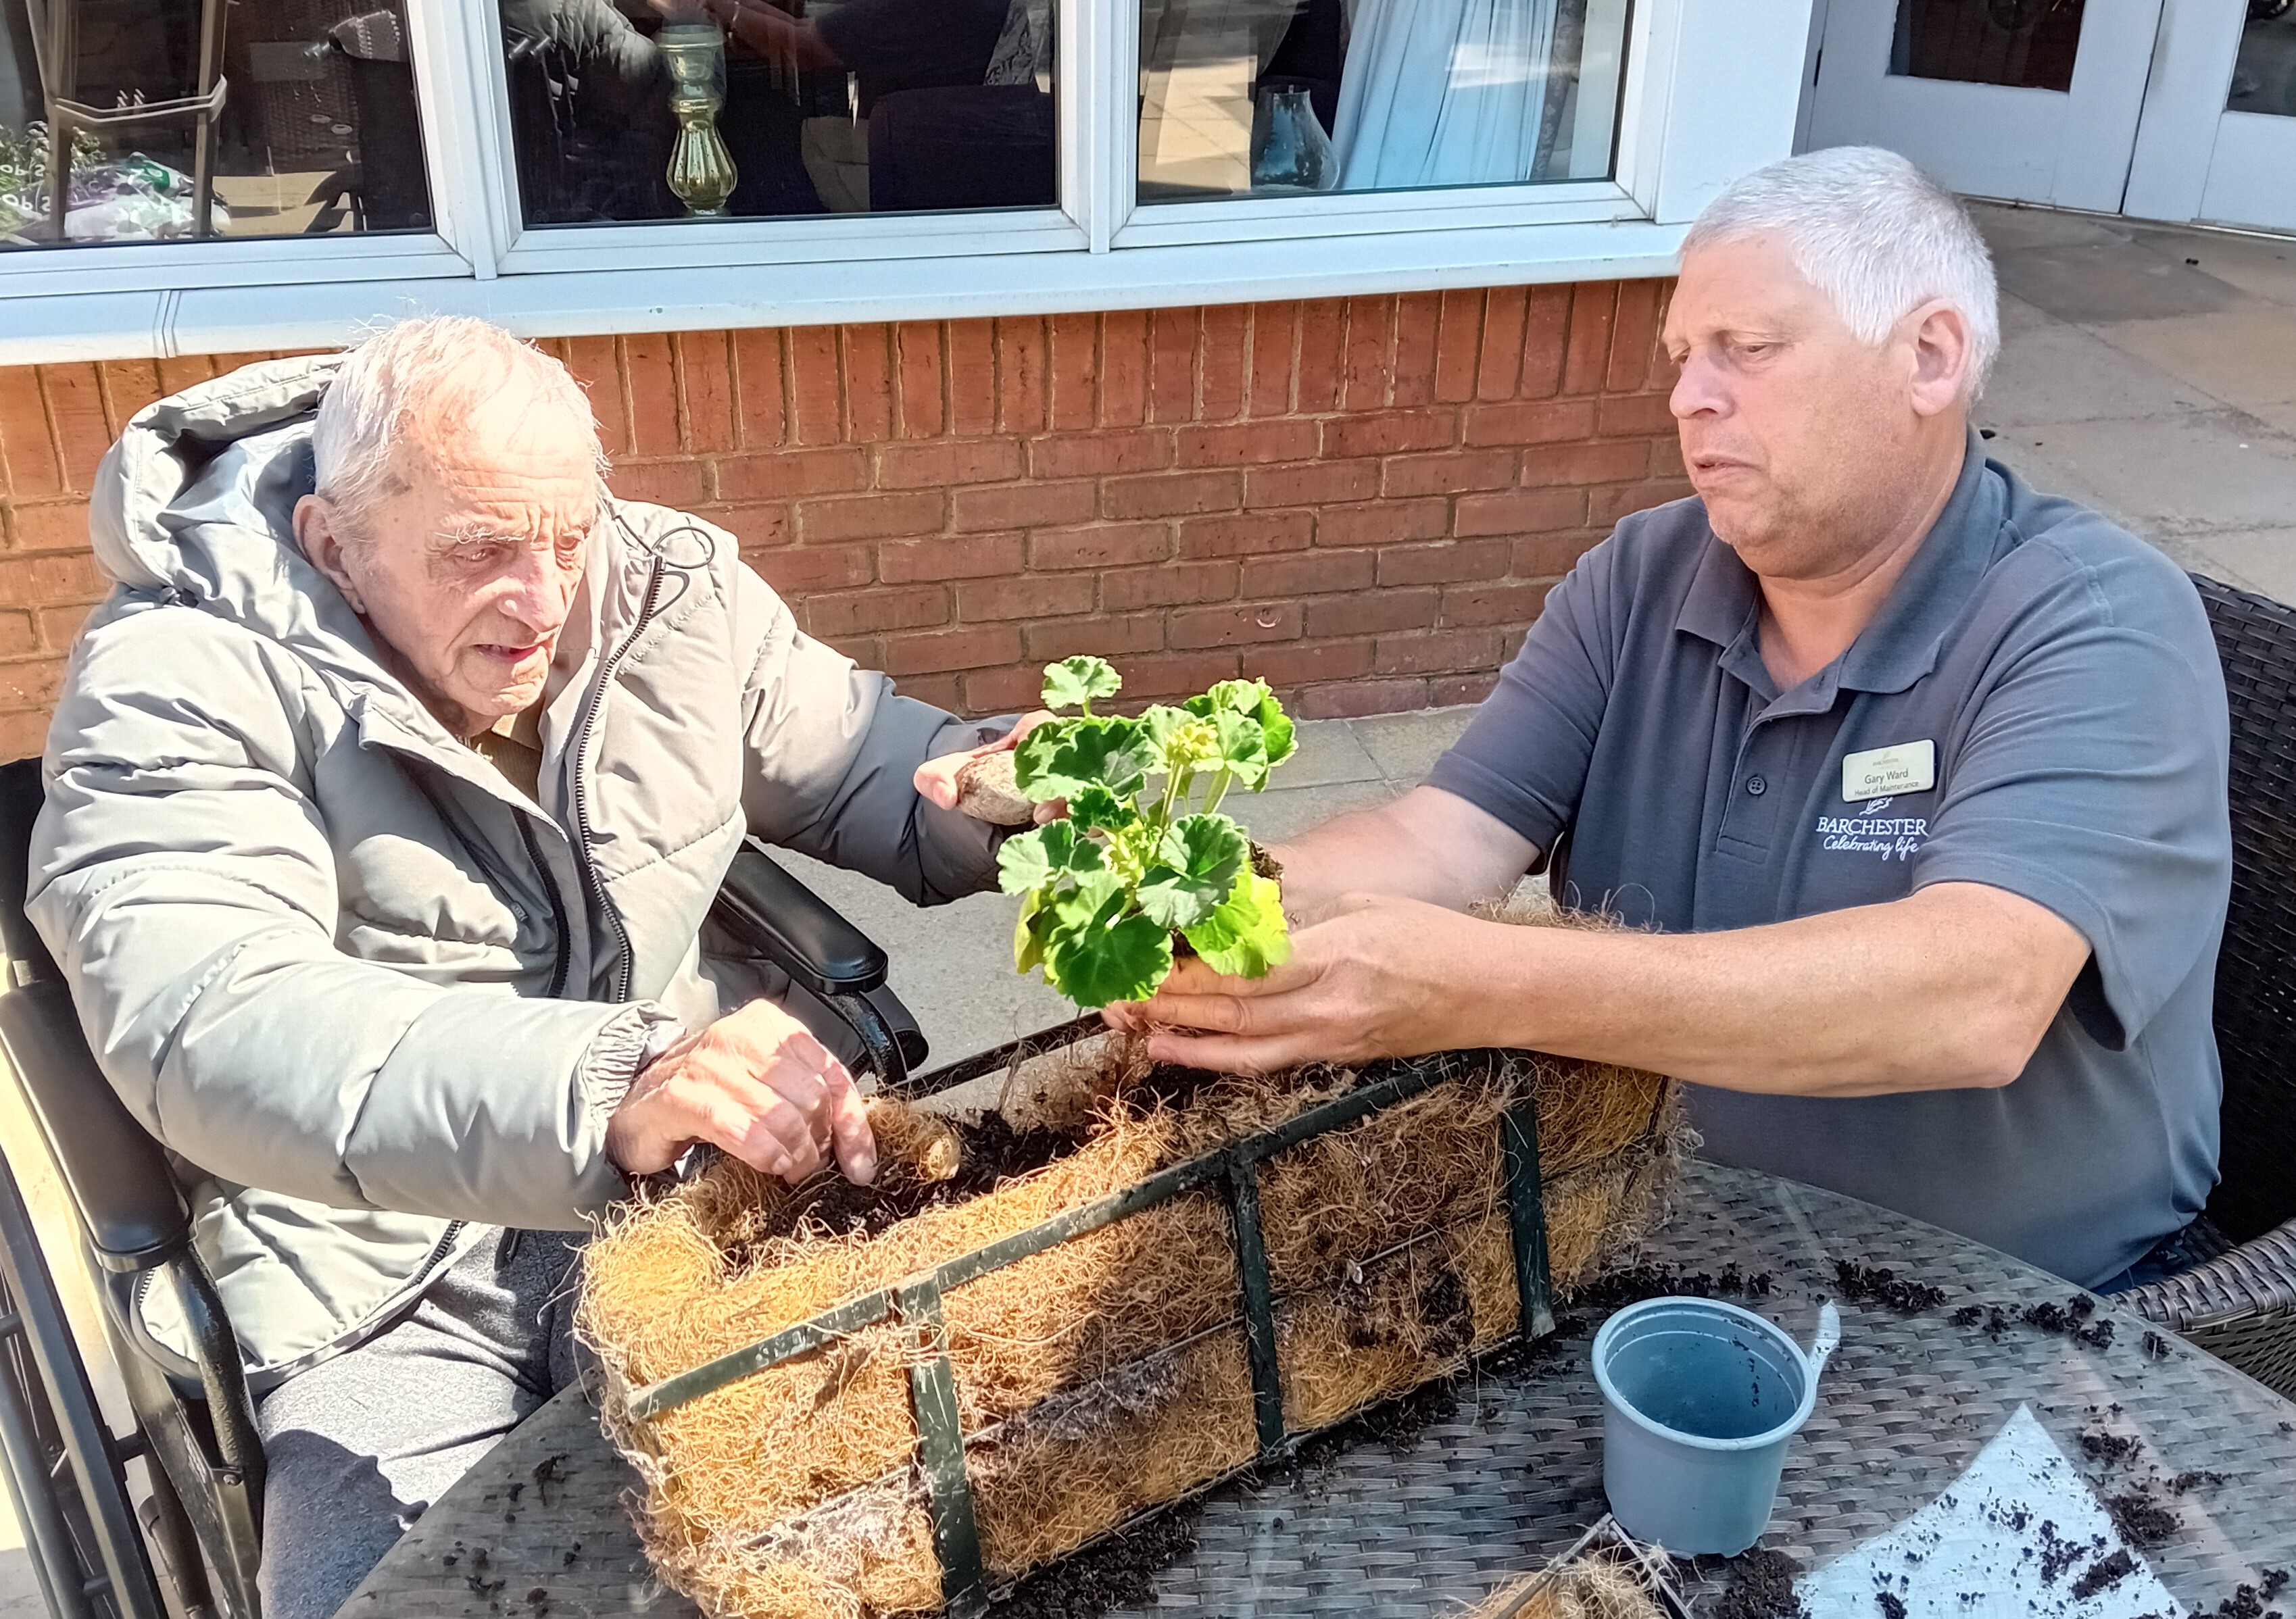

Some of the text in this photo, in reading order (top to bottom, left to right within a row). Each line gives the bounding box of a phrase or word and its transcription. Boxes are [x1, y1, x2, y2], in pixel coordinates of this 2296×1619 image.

[1864, 768, 1909, 785] Gary Ward
[1855, 780, 1920, 796] Head of Maintenance
[1815, 816, 1930, 837] BARCHESTER
[1823, 835, 1920, 862] Celebrating life
